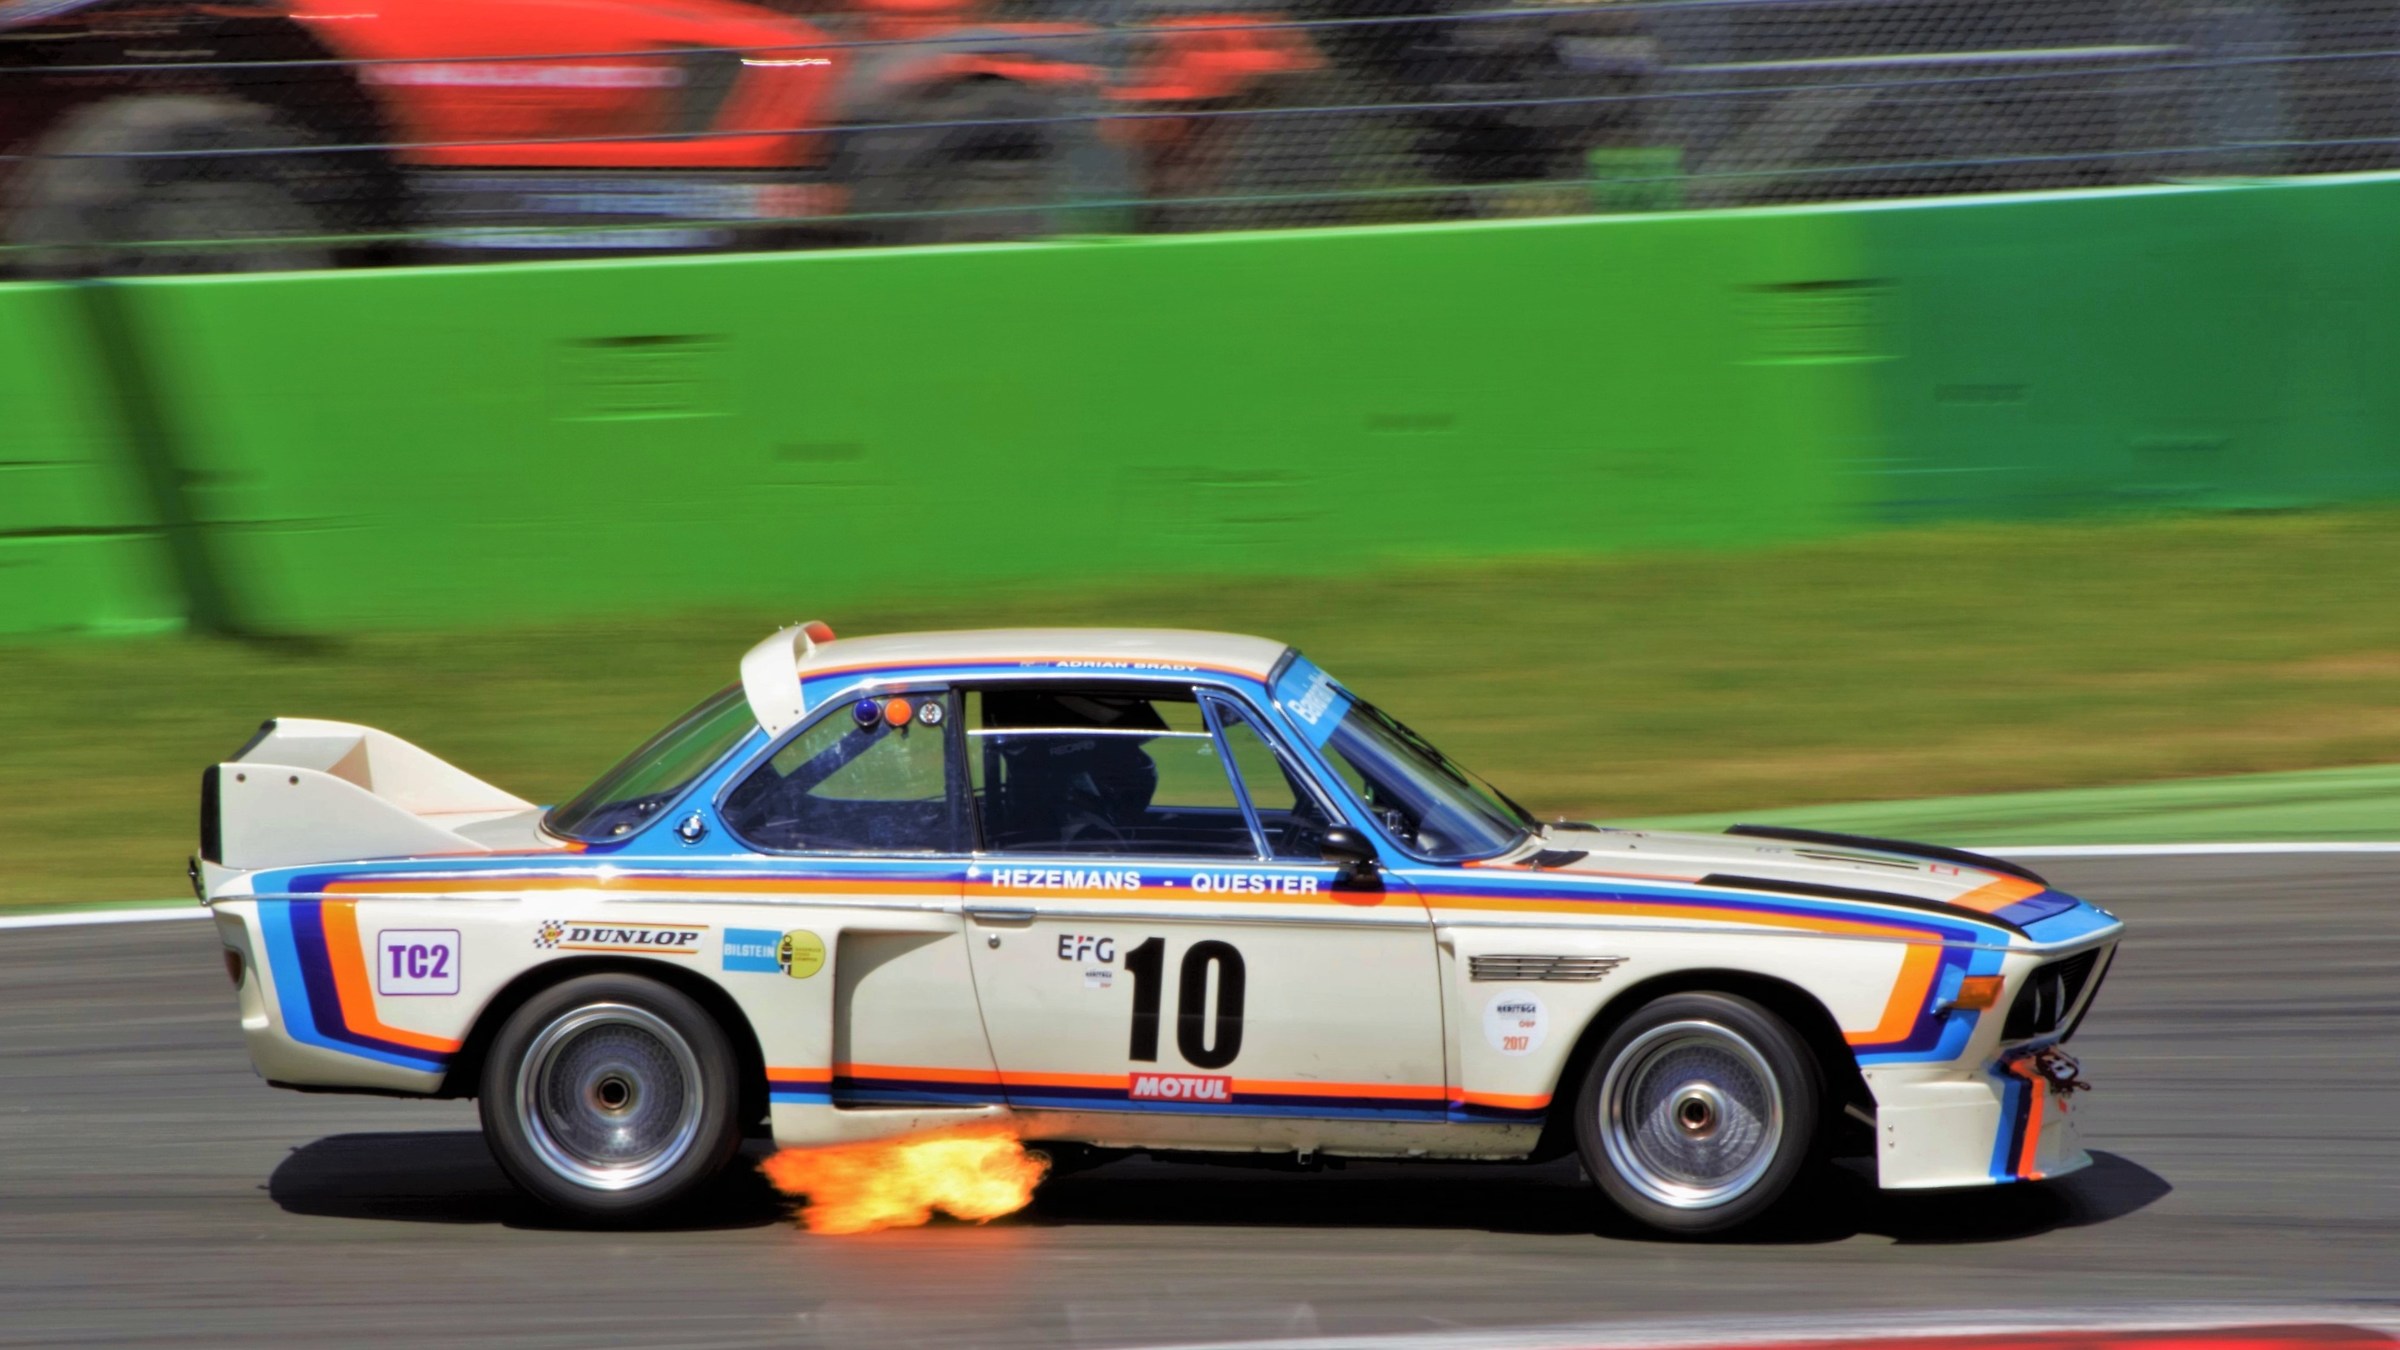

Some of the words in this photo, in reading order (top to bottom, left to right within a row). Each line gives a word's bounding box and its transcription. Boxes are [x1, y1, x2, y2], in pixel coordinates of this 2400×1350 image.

[1134, 663, 1198, 672] BRADY
[992, 869, 1141, 890] HEZEMANS
[1191, 874, 1318, 895] QUESTER
[567, 928, 698, 945] DUNLOP
[724, 943, 775, 958] BILSTEIN
[1058, 934, 1114, 963] EFG
[388, 944, 449, 979] TC2
[1124, 936, 1246, 1069] 10
[1503, 1036, 1529, 1050] 2017
[1133, 1076, 1228, 1099] MOTUL
